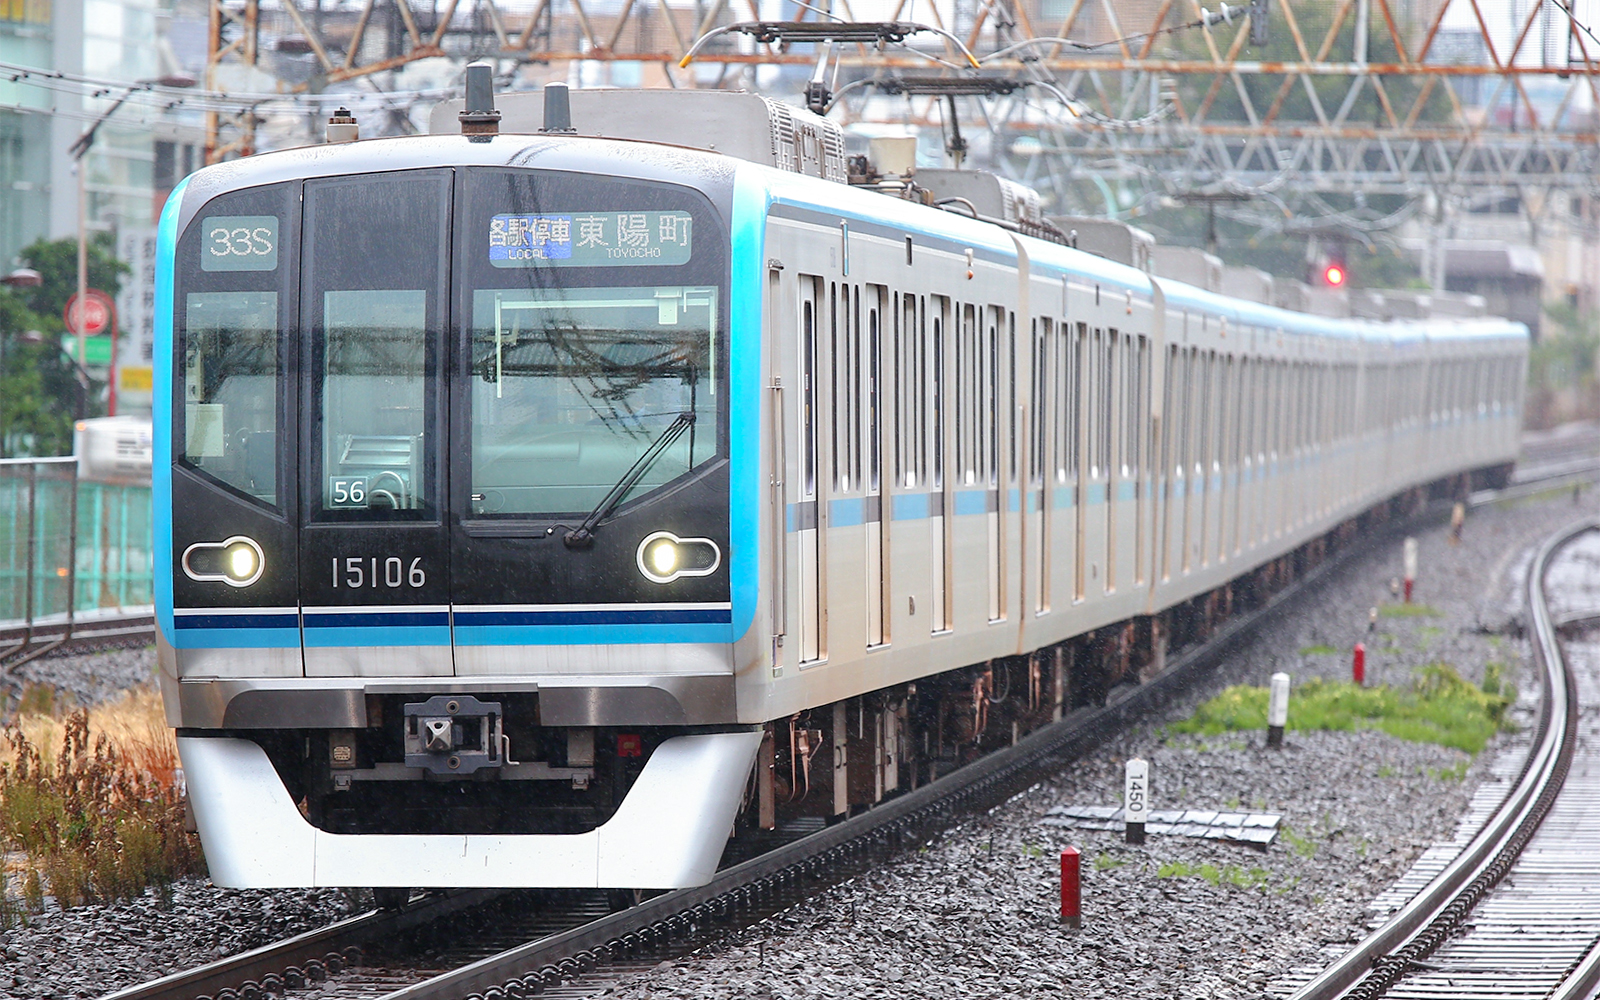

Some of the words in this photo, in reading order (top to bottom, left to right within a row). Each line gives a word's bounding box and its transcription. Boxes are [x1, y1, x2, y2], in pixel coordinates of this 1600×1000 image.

[210, 227, 273, 256] 33S
[489, 217, 571, 247] 各駅停車
[575, 214, 692, 248] 東陽町
[508, 248, 548, 260] LOCAL
[606, 247, 661, 259] TOYOCHO
[334, 481, 364, 503] 56
[332, 557, 426, 588] 15106
[1129, 774, 1143, 812] 1450
